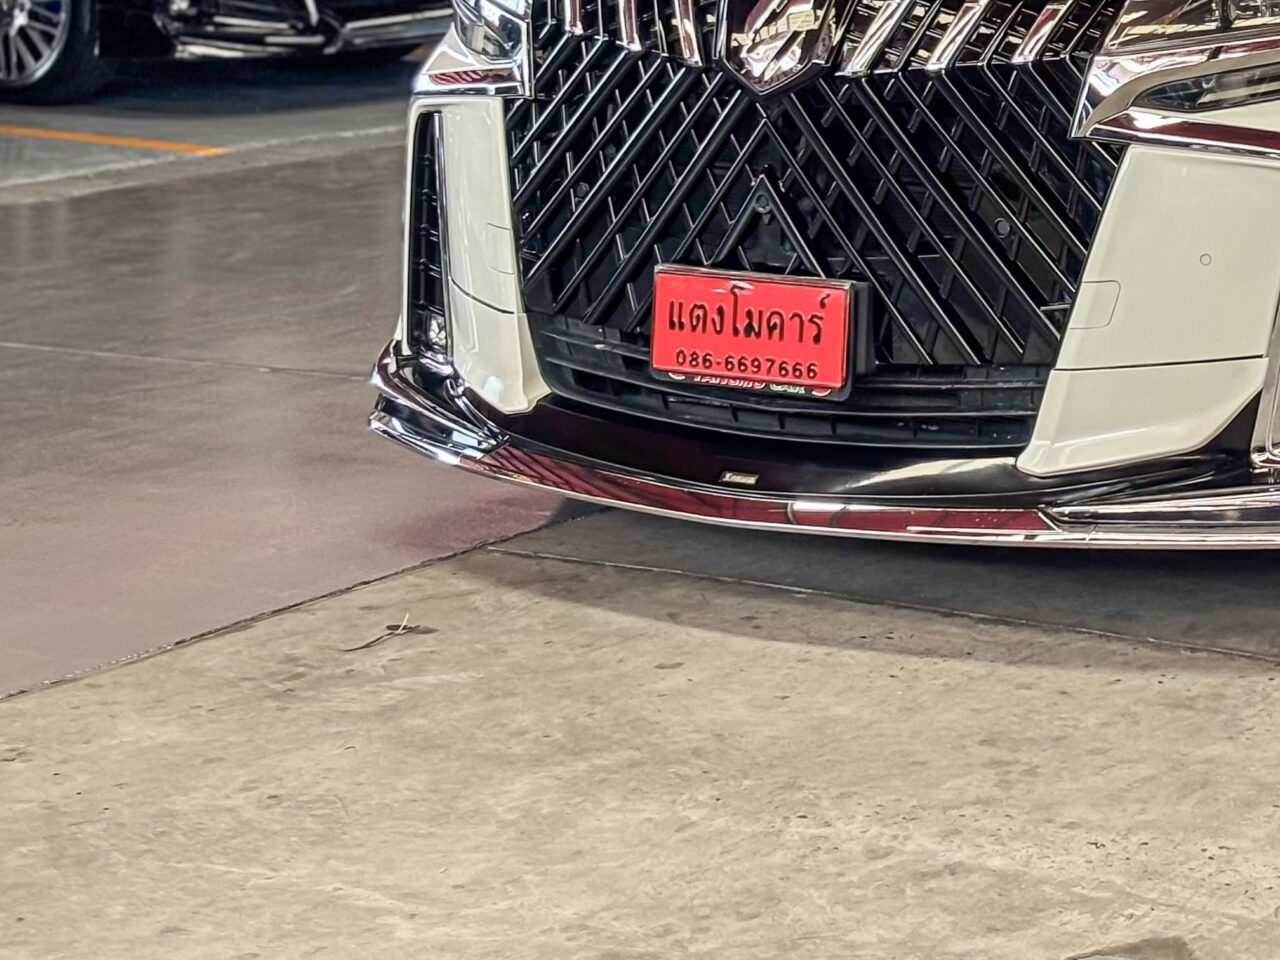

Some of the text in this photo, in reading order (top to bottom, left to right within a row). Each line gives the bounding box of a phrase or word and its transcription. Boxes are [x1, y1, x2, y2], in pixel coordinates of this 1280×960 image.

[668, 283, 831, 345] แตงโมคาร์
[676, 349, 818, 379] 086-6697666
